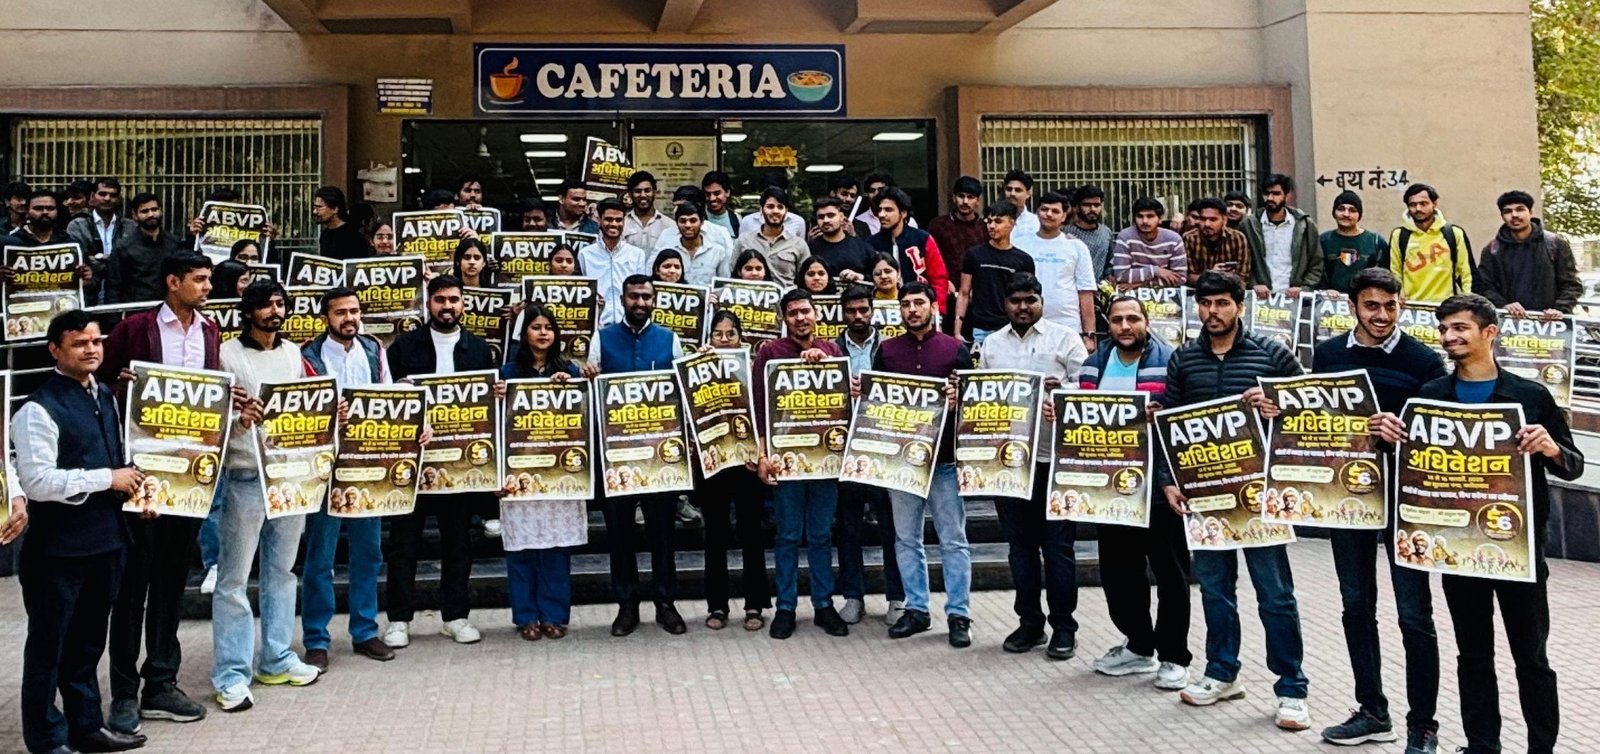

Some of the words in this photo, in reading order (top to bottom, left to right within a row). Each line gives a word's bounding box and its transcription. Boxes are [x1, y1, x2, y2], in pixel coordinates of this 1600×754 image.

[536, 62, 787, 99] CAFETERIA
[592, 146, 630, 165] ABV
[207, 210, 263, 228] ABVP
[402, 219, 460, 238] ABVP
[13, 253, 75, 271] ABVP
[296, 264, 344, 285] ABV
[353, 267, 417, 287] ABVP
[461, 295, 504, 313] BVP
[531, 286, 592, 304] ABVP
[656, 291, 700, 313] BVP
[720, 287, 780, 309] ABVP
[652, 309, 698, 328] धिवेशन
[1501, 318, 1567, 336] ABVP
[688, 359, 741, 388] ABVP
[774, 370, 843, 391] ABVP
[140, 376, 224, 409] ABVP
[263, 388, 335, 415] ABVP
[512, 389, 583, 411] ABVP
[606, 381, 675, 405] ABVP
[692, 382, 741, 404] अधिवेशन
[776, 391, 844, 408] अधिवेशन
[867, 382, 939, 408] ABVP
[962, 381, 1032, 402] ABVP
[1277, 386, 1365, 411] ABVP
[141, 404, 222, 430] अधिवेशन
[347, 397, 422, 420] ABVP
[427, 405, 489, 424] धिवेशन
[608, 404, 676, 422] अधिवेशन
[865, 403, 935, 424] अधिवेशन
[962, 402, 1029, 421] अधिवेशन
[1063, 402, 1138, 426] ABVP
[263, 413, 332, 434] अधिवेशन
[346, 420, 418, 439] अधिवेशन
[513, 411, 582, 428] अधिवेशन
[1169, 410, 1247, 447] ABVP
[1283, 410, 1370, 433] अधिवेशन
[1063, 425, 1139, 446] अधिवेशन
[1409, 414, 1512, 450] ABVP
[1177, 439, 1254, 466] अधिवेशन
[1409, 446, 1511, 473] अधिवेशन
[1486, 507, 1513, 531] 56
